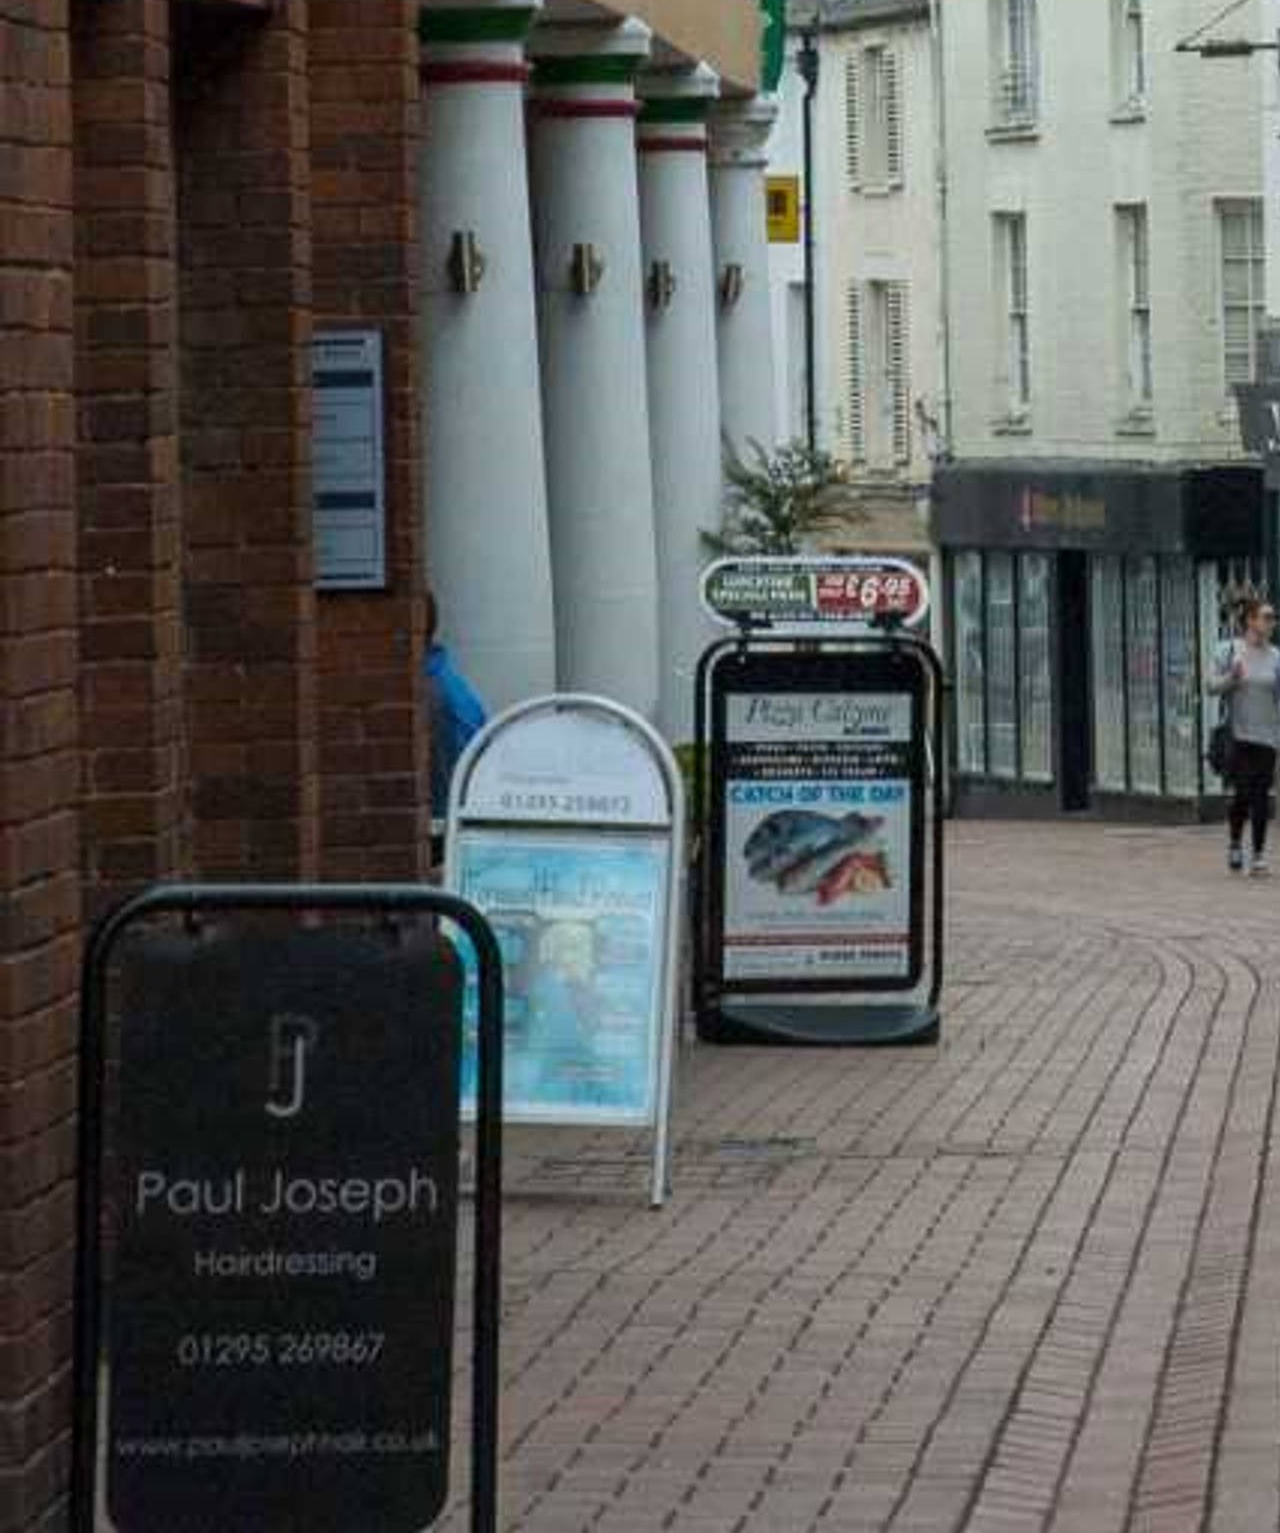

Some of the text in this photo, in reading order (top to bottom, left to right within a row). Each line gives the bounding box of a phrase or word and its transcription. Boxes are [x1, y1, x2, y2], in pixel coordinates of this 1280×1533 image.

[731, 785, 793, 804] CATCH
[136, 1168, 439, 1227] Paul Joseph
[193, 1247, 377, 1280] Hairdressing
[177, 1331, 386, 1366] 01295 269867
